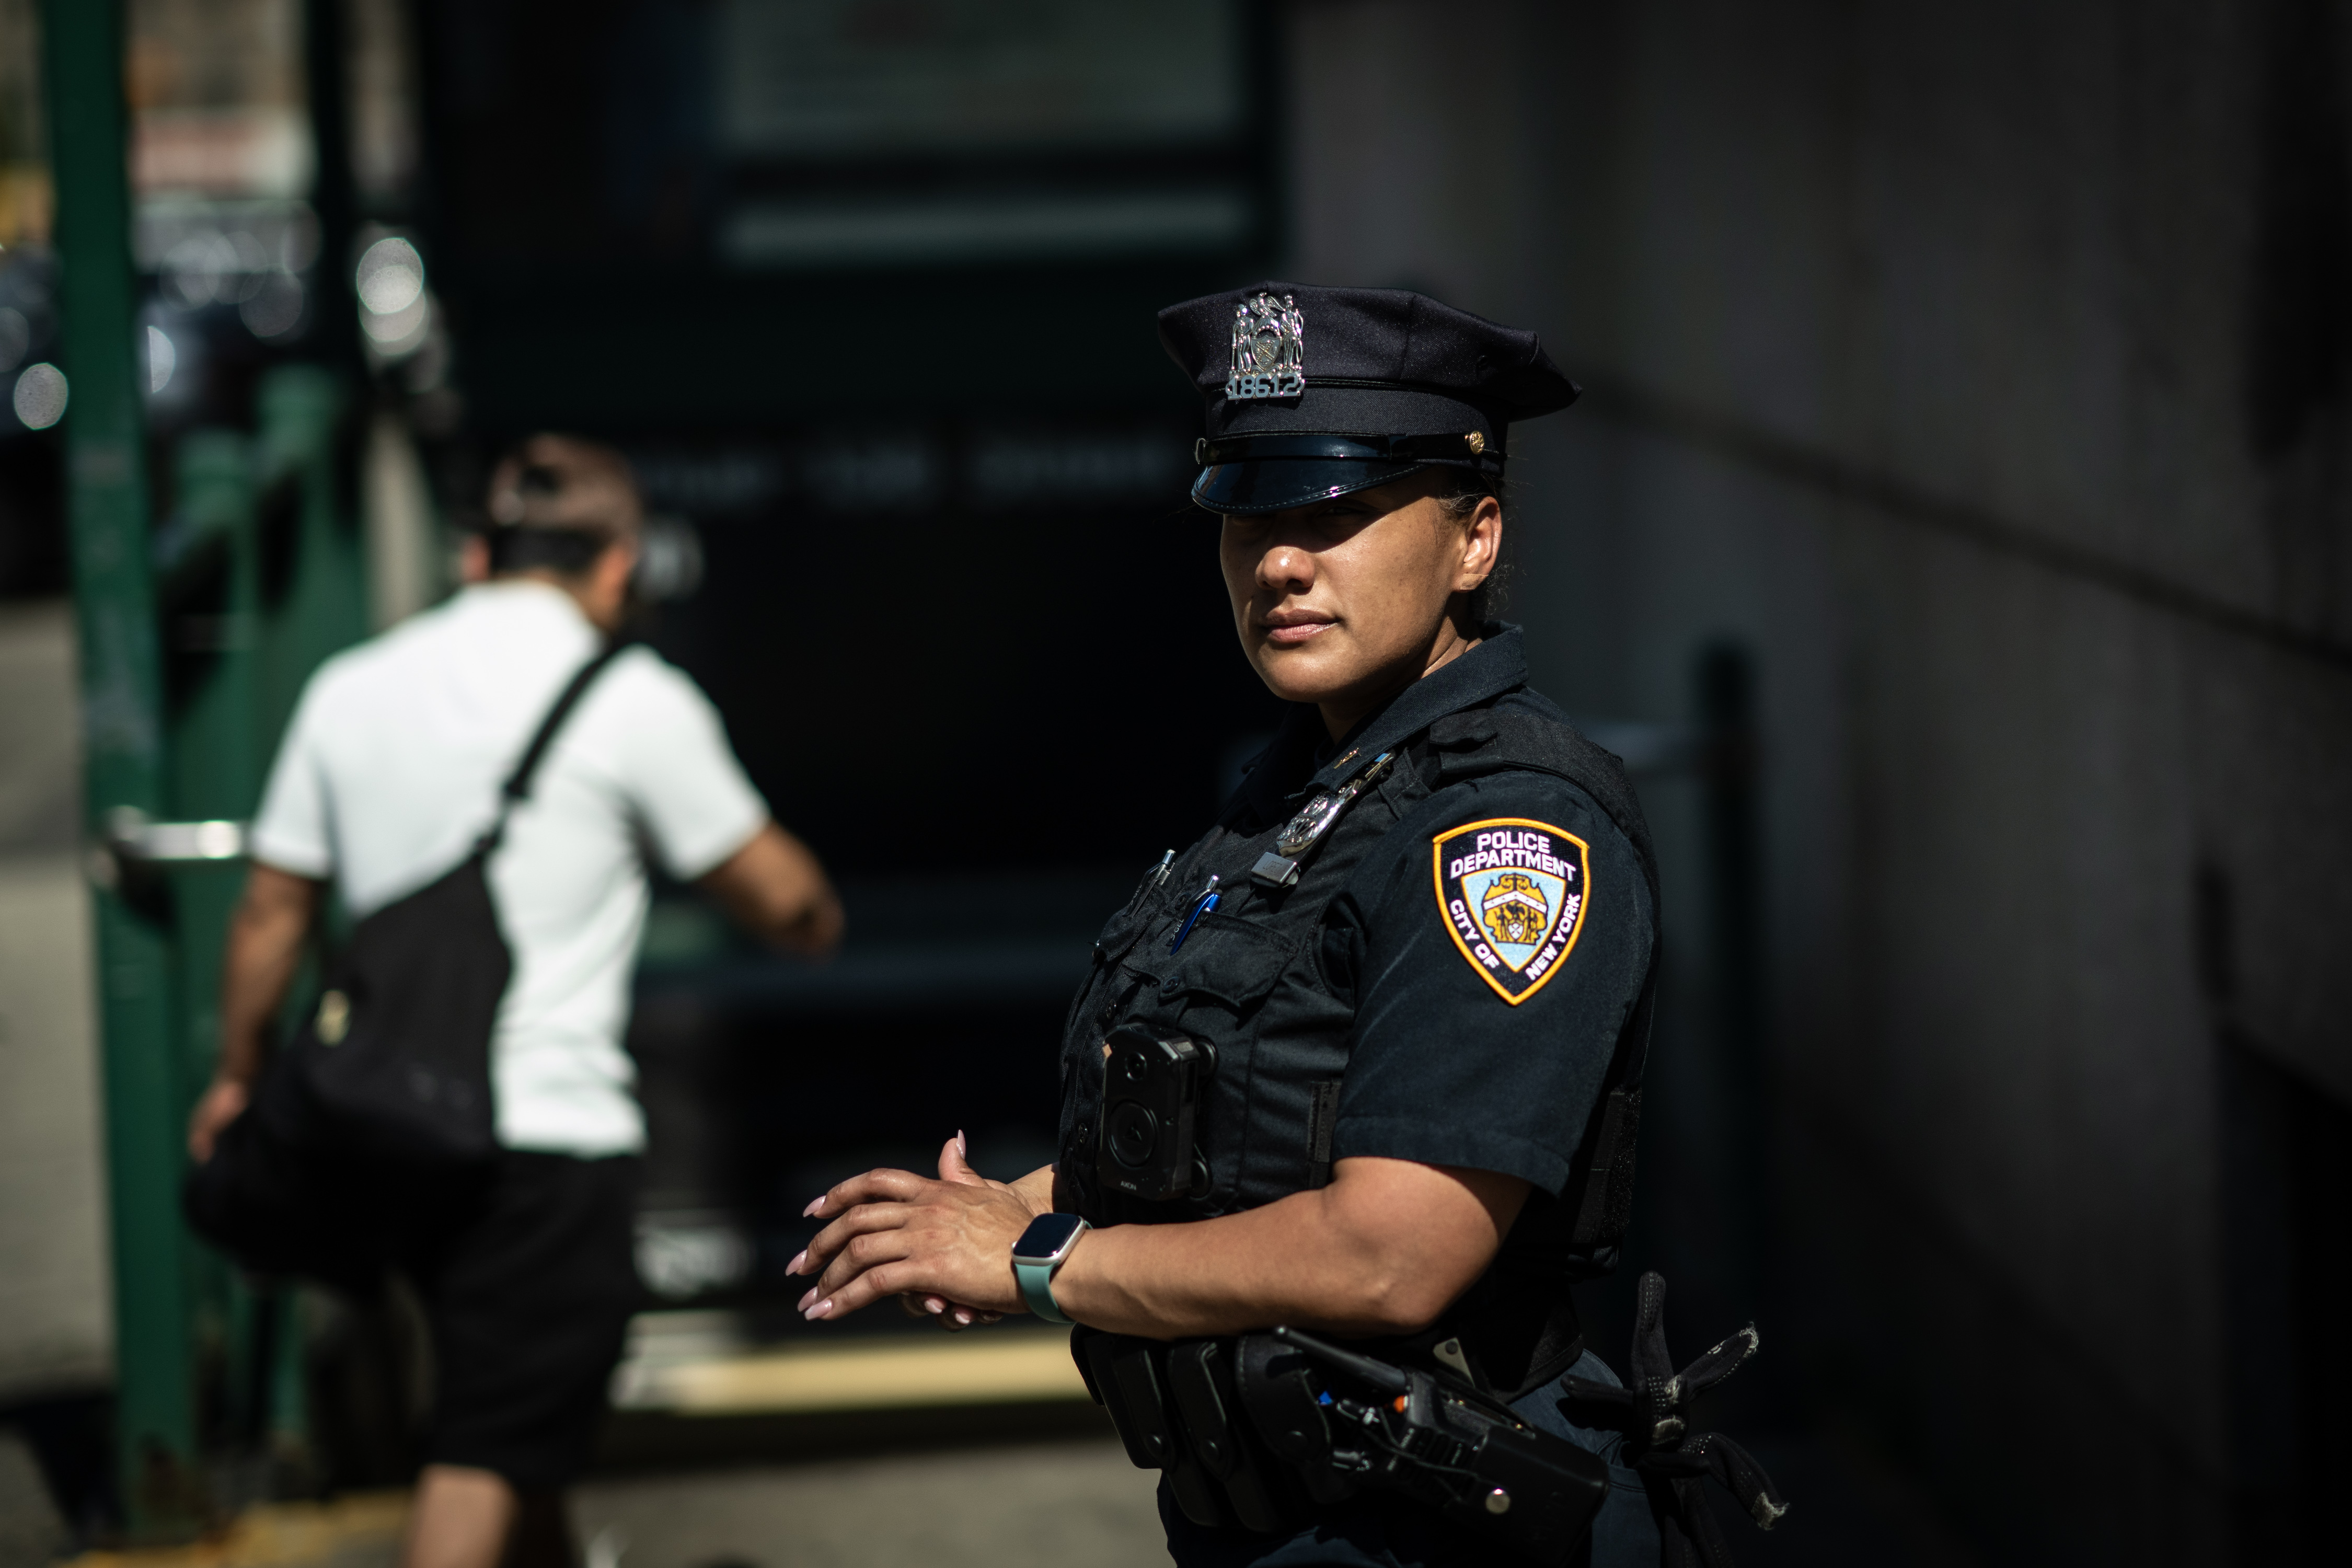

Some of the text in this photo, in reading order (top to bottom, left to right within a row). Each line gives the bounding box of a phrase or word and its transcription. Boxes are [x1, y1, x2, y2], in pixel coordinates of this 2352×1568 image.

[1227, 373, 1300, 400] 18612
[1477, 831, 1550, 854] POLICE
[1450, 849, 1576, 881] DEPARTMENT
[1170, 918, 1184, 941] S-GEL
[1450, 899, 1500, 968] CITY OF
[1525, 893, 1581, 981] NEW YORK
[1120, 1180, 1137, 1191] AXON
